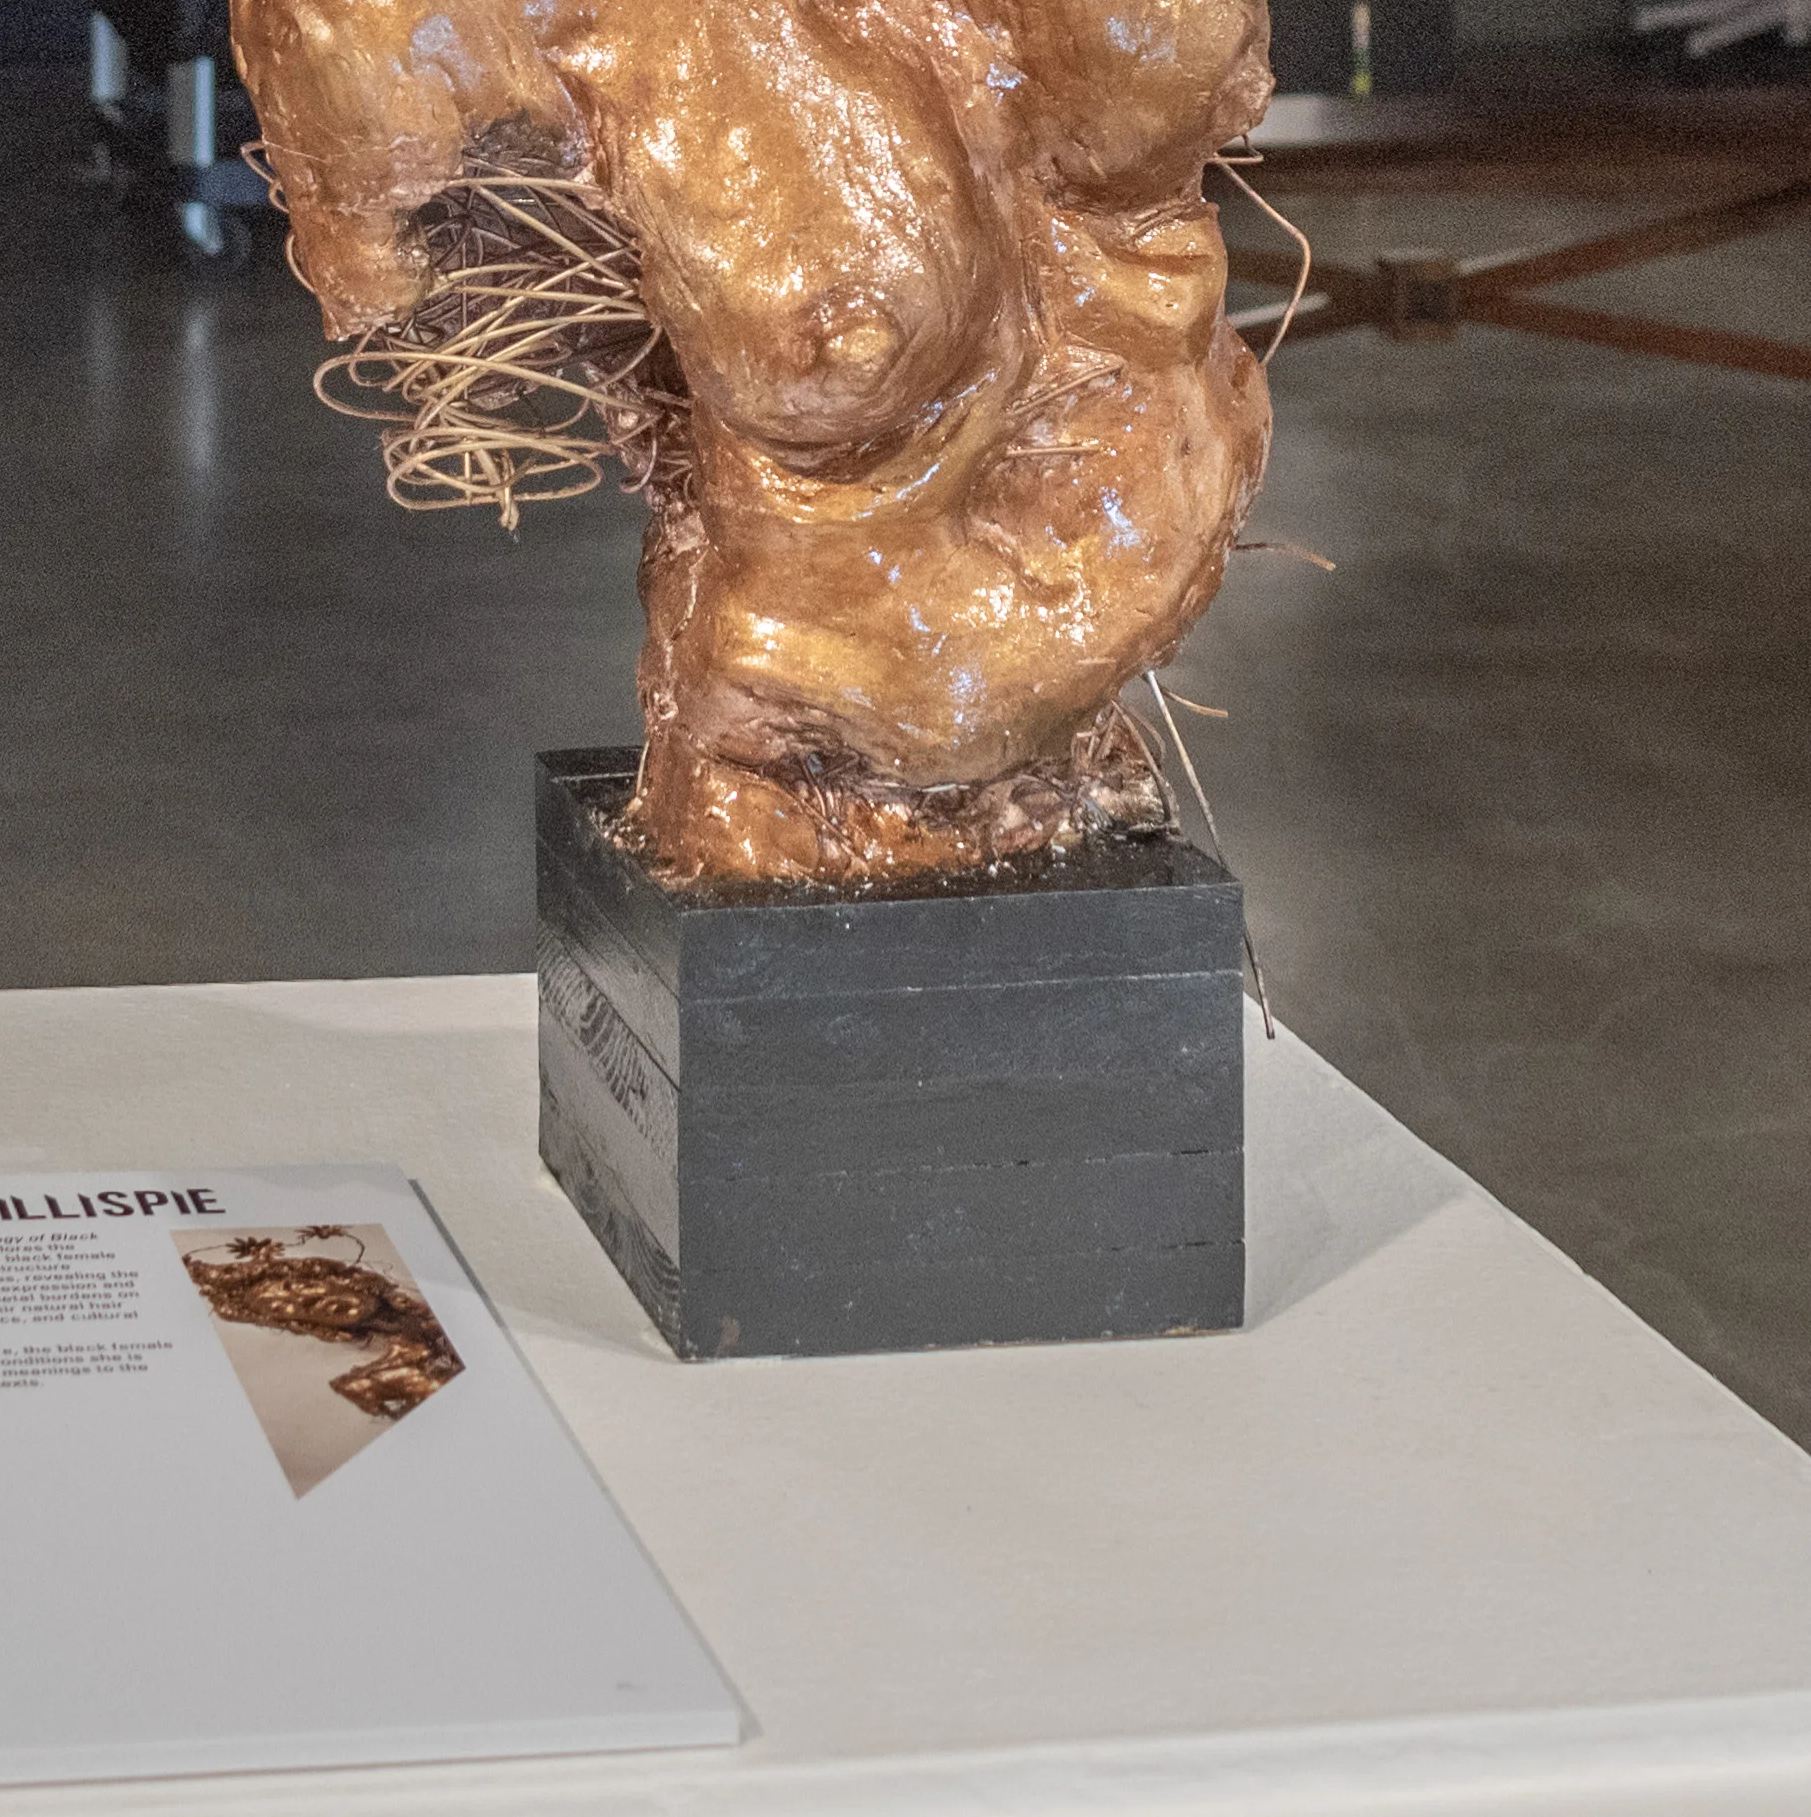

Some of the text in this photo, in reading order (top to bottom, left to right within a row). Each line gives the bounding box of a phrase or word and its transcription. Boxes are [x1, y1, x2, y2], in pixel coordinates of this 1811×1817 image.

[28, 1232, 44, 1241] of
[50, 1230, 98, 1240] Black
[46, 1241, 74, 1250] the
[4, 1252, 50, 1262] black
[56, 1250, 115, 1260] female
[24, 1270, 106, 1282] revealing
[110, 1269, 138, 1278] the
[0, 1280, 96, 1293] expression
[102, 1279, 134, 1288] and
[39, 1290, 112, 1301] burdens
[21, 1301, 84, 1312] natural
[88, 1300, 122, 1309] hair
[32, 1313, 64, 1322] and
[70, 1310, 138, 1320] cultural
[22, 1345, 51, 1354] the
[56, 1343, 106, 1353] black
[110, 1340, 172, 1350] female
[89, 1352, 122, 1361] she
[1, 1364, 91, 1377] meanings
[95, 1363, 114, 1372] to
[118, 1362, 148, 1371] the
